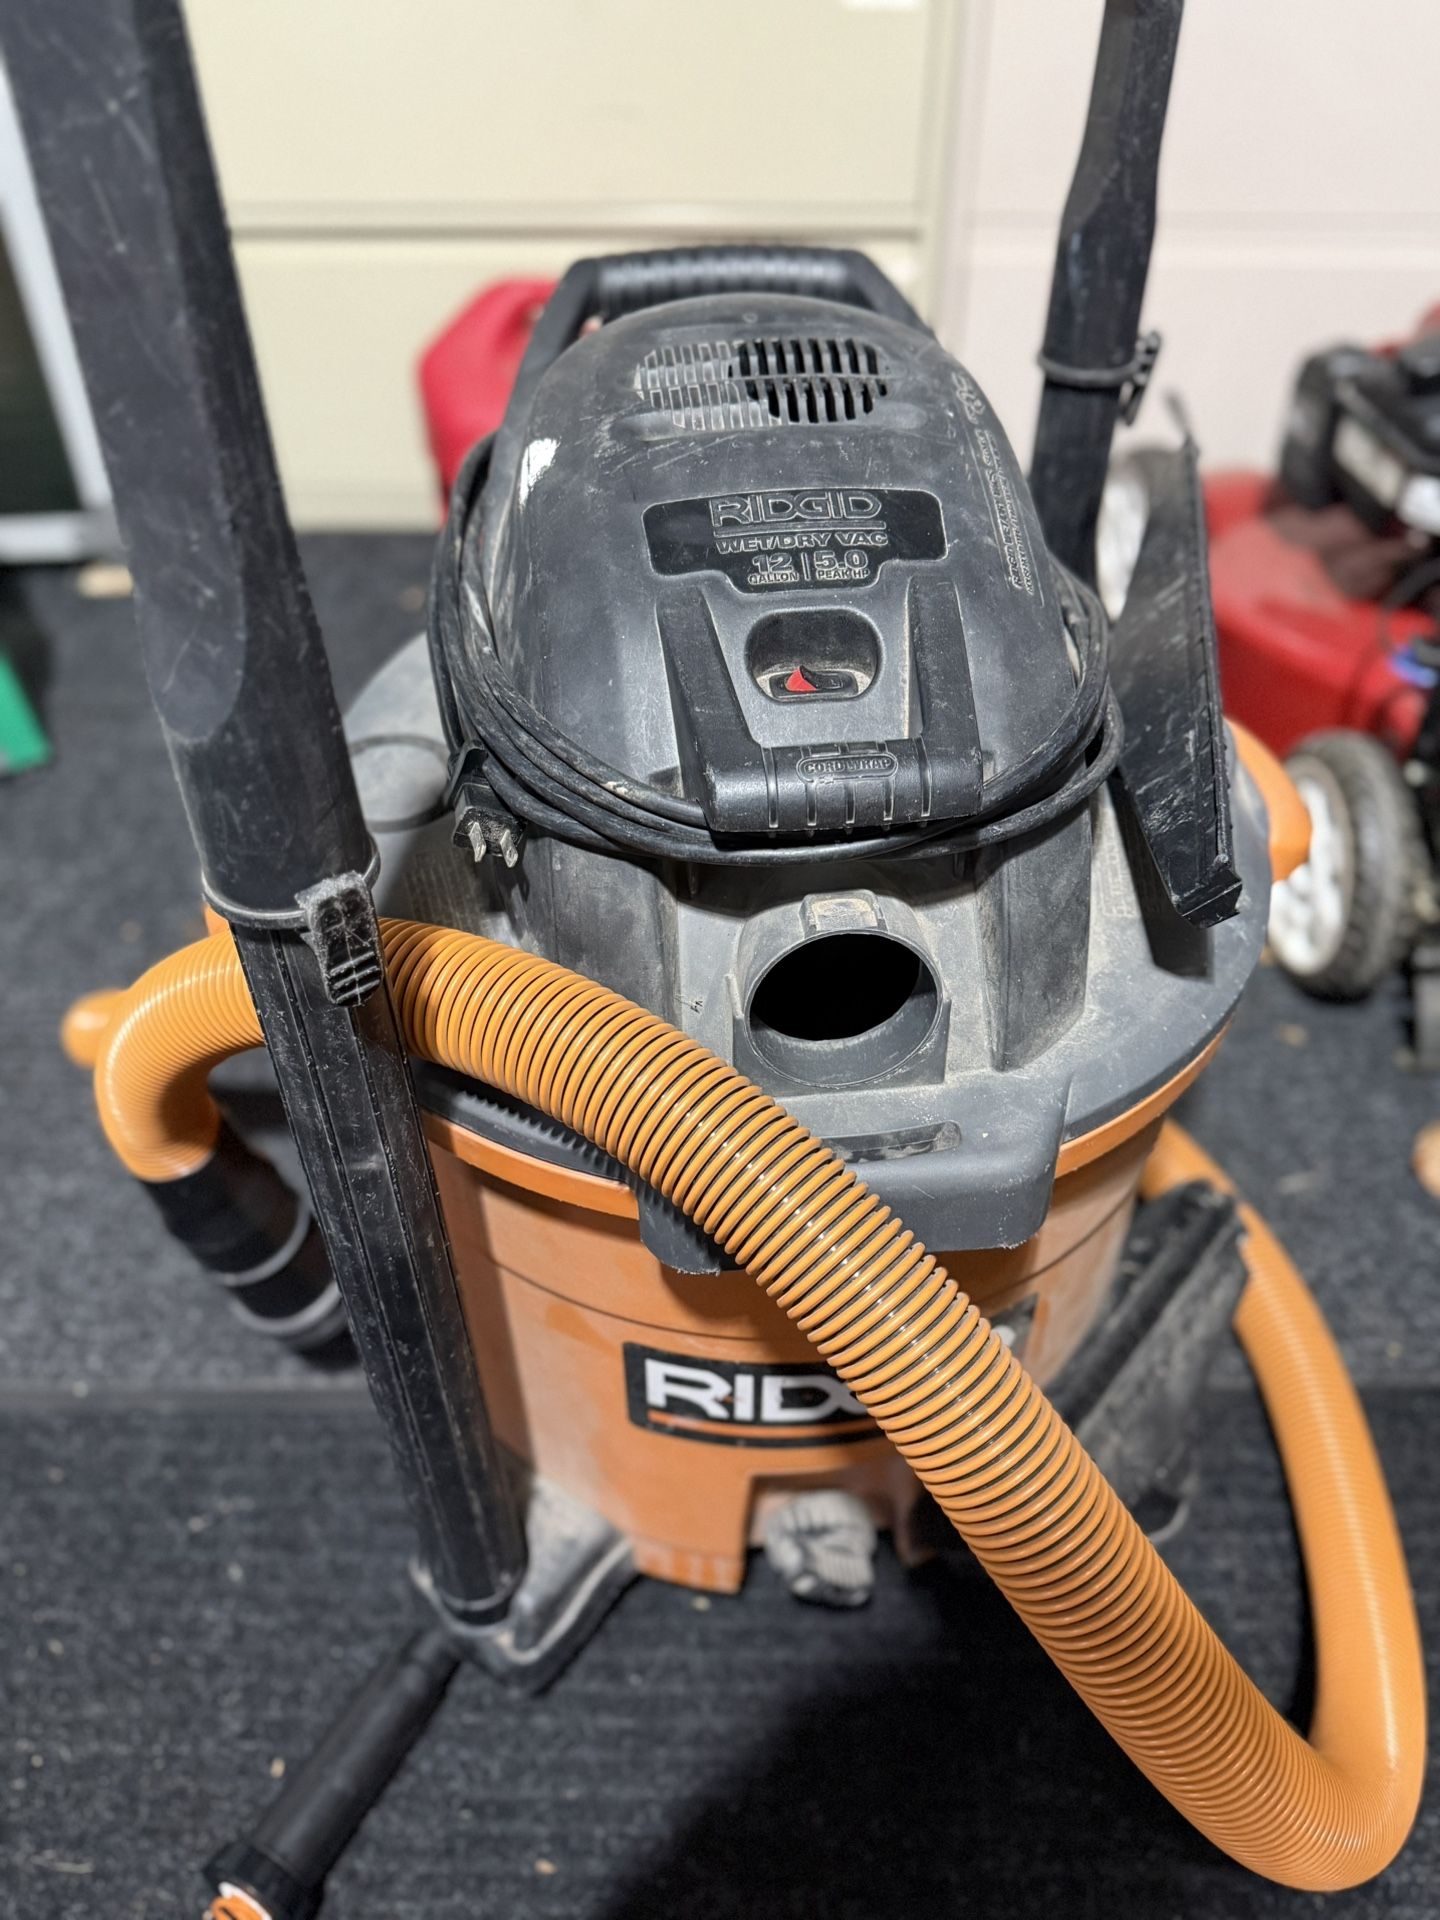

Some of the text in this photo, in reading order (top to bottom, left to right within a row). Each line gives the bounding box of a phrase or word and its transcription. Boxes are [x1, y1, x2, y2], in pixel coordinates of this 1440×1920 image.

[709, 490, 883, 527] RIDGID
[715, 531, 889, 554] WET/DRY VAC
[752, 553, 794, 574] 12
[813, 550, 869, 570] 5.0
[747, 571, 800, 585] GALLON
[815, 567, 872, 580] PEAK HP
[804, 759, 893, 774] CORD WRAP
[644, 1358, 870, 1422] RID
